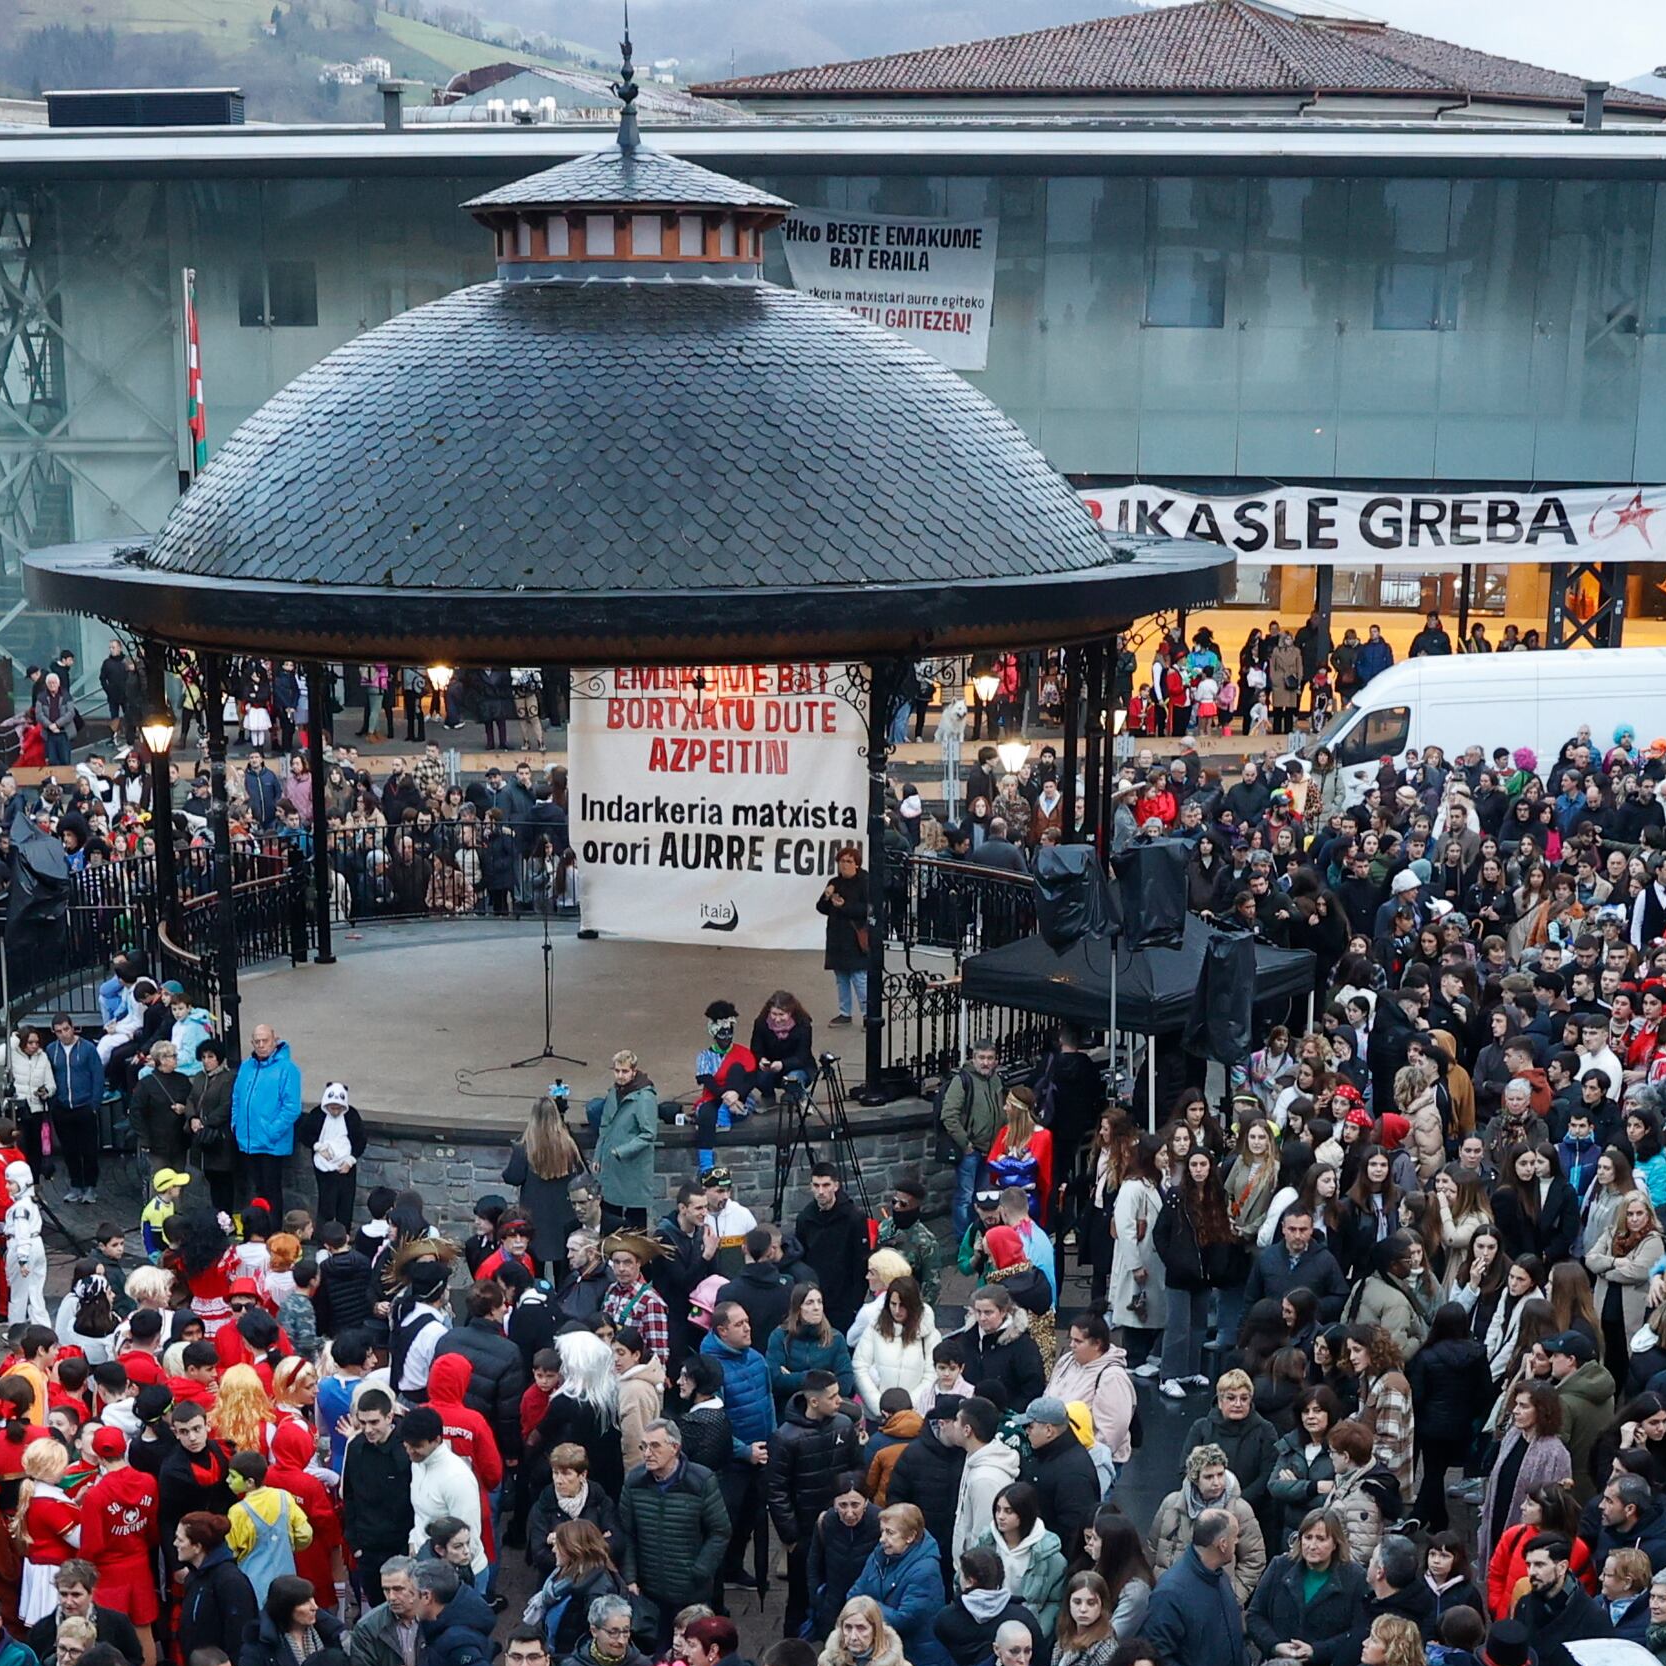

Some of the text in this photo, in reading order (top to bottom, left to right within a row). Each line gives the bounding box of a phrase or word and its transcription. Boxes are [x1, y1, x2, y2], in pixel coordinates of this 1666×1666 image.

[826, 222, 880, 246] BESTE
[886, 224, 983, 250] EMAKUME
[830, 247, 930, 272] BAT ERAILA
[844, 290, 905, 305] matxistari
[907, 294, 938, 307] aurre
[941, 294, 985, 310] egiteko
[885, 308, 973, 335] GAITEZEN!
[1117, 497, 1339, 552] IKASLE
[1358, 496, 1579, 551] GREBA
[614, 663, 830, 694] EMAKUME BAT
[606, 697, 837, 733] BORTXATU DUTE
[648, 737, 790, 775] AZPEITIN
[581, 792, 858, 830] Indarkeria matxista
[583, 836, 650, 866] orori
[658, 831, 765, 872] AURRE
[700, 902, 732, 919] itaia
